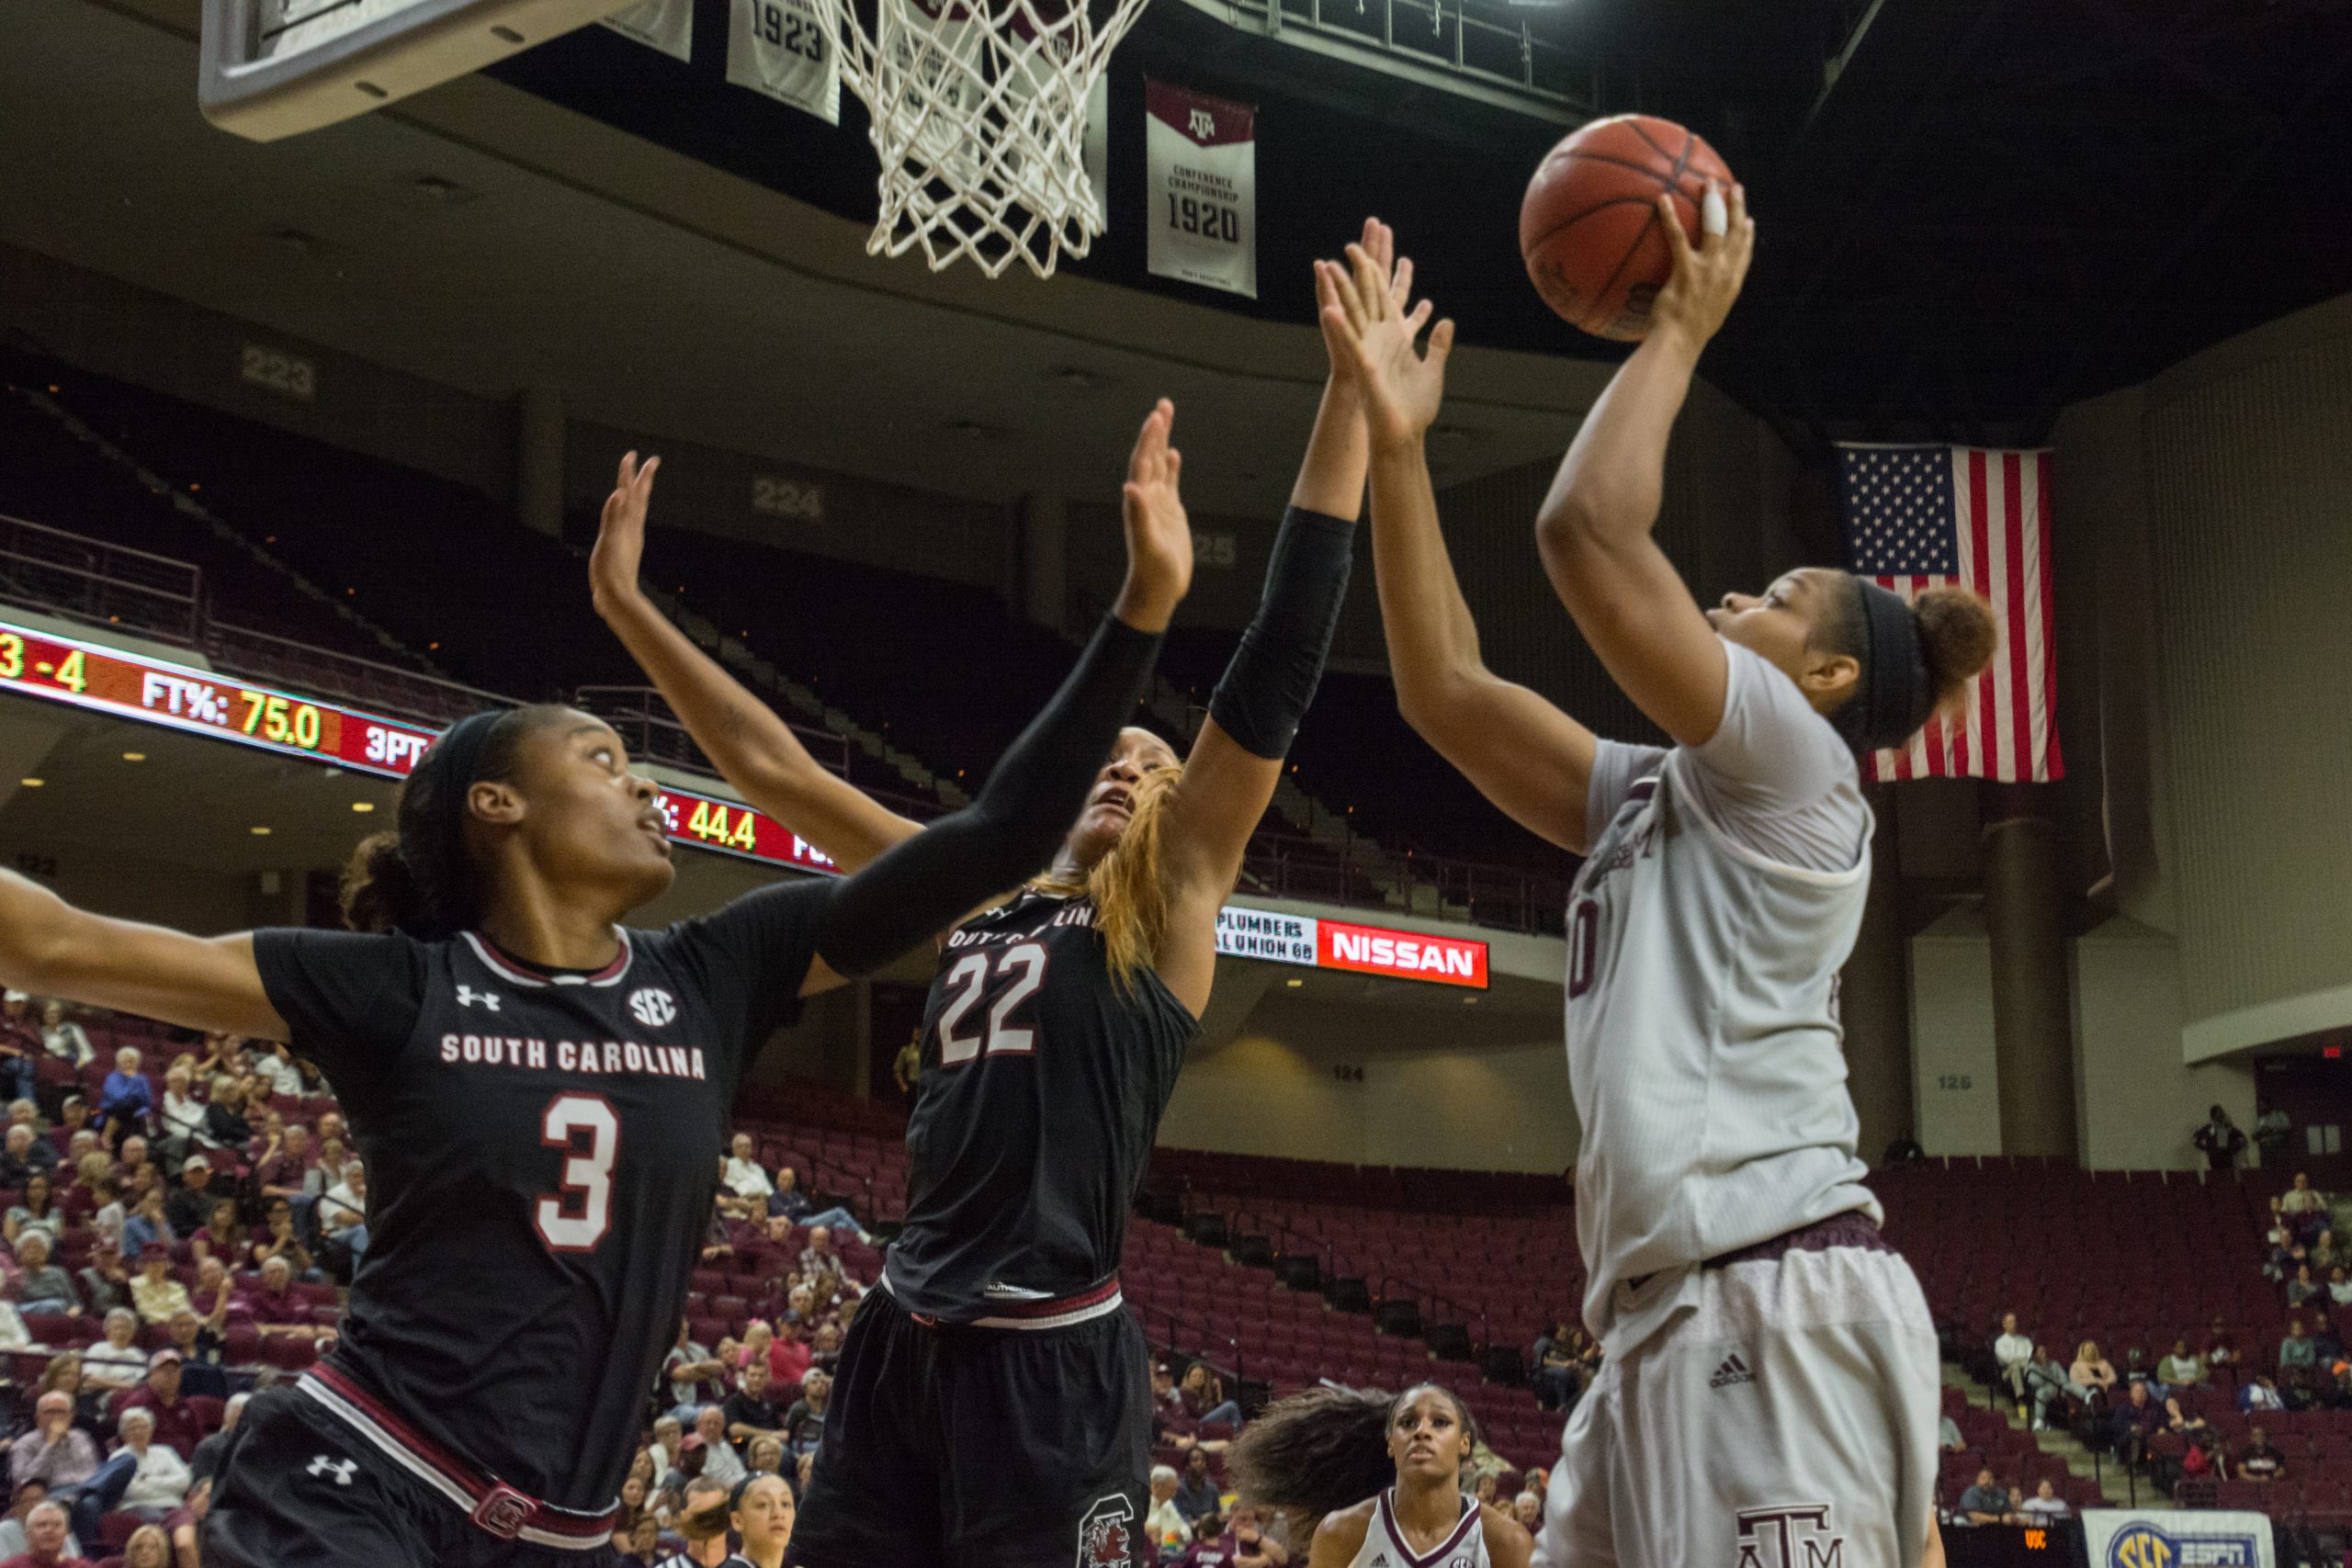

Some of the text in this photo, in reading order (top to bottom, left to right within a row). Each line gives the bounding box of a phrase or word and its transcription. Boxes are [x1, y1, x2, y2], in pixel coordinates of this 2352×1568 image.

[1168, 175, 1239, 203] CHAMPIONSHIP
[1173, 164, 1233, 189] CONFERENCE
[1168, 193, 1239, 244] 1920
[242, 345, 312, 396] 223
[753, 478, 822, 521] 224
[143, 671, 229, 726] FT%:
[240, 689, 321, 750] 75.0
[687, 800, 756, 852] 44.4
[1216, 911, 1303, 939] PLUMBERS
[1236, 935, 1287, 958] UNION
[1332, 931, 1475, 977] NISSAN
[629, 988, 677, 1027] SEC
[939, 943, 1046, 1066] 22
[440, 1033, 707, 1080] SOUTH CAROLINA
[535, 1092, 619, 1251] 3
[2181, 1542, 2245, 1566] ESPN
